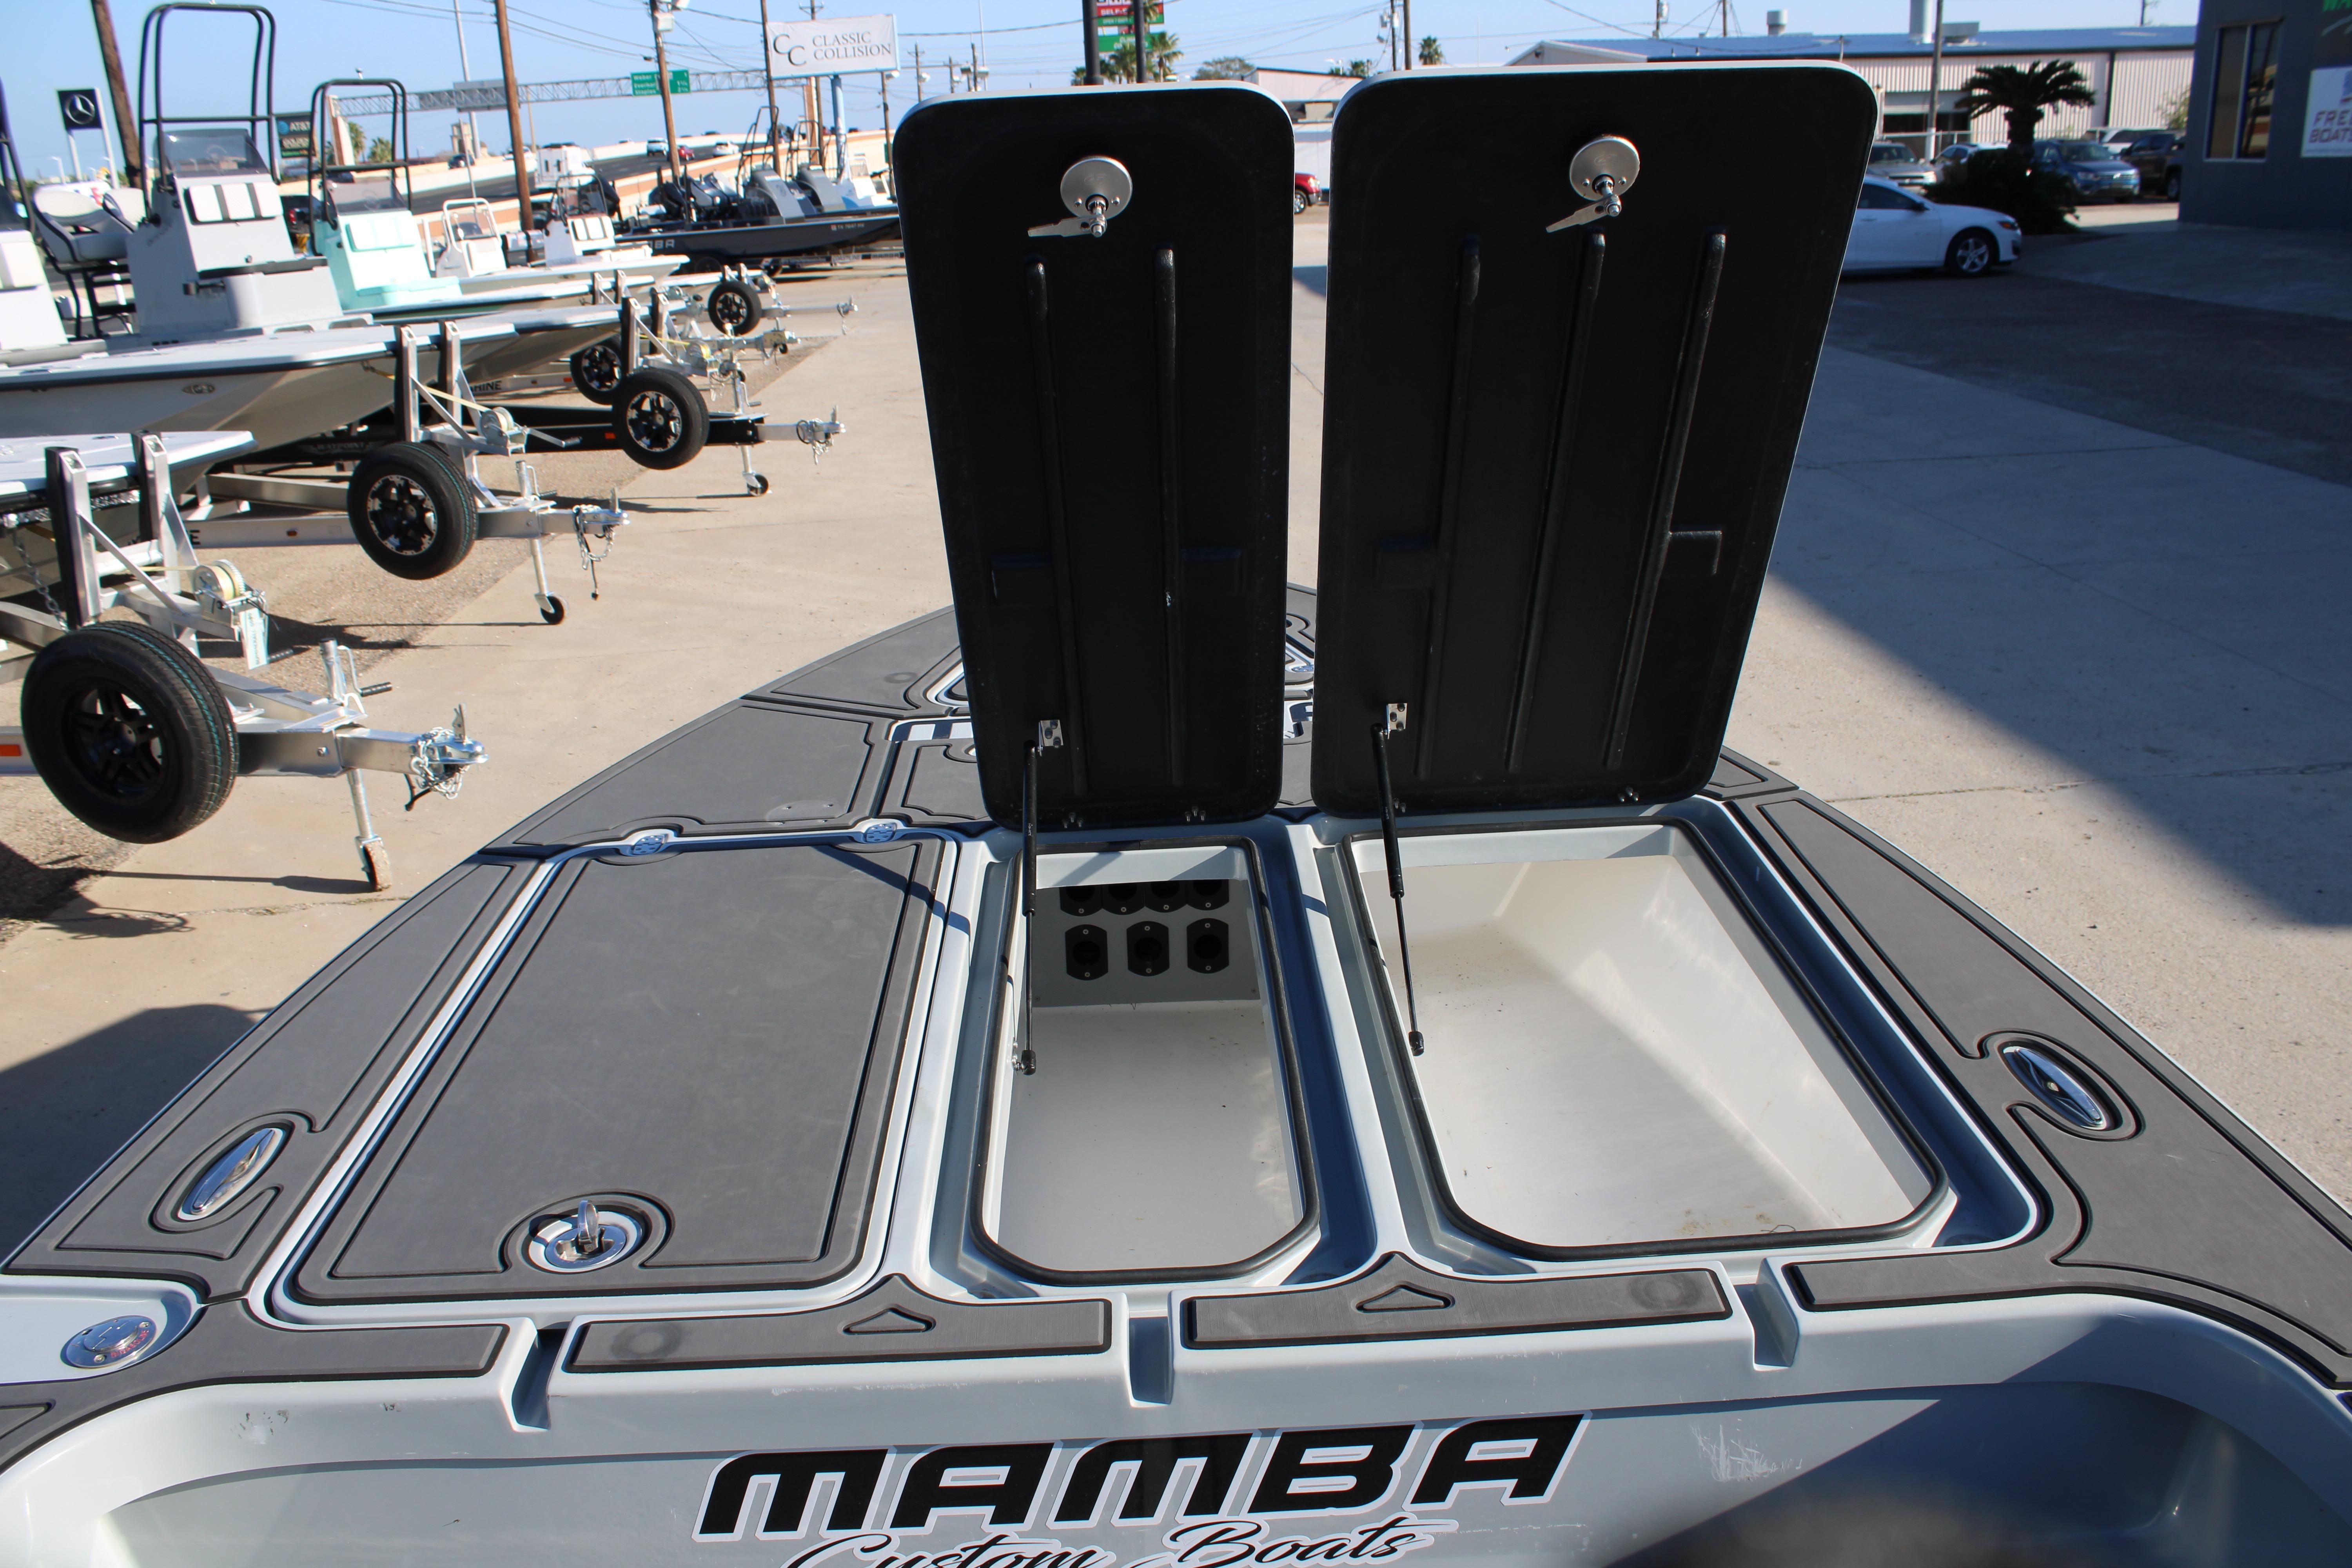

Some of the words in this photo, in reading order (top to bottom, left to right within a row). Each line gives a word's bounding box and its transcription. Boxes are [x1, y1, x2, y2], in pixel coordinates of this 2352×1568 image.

[812, 31, 871, 47] CLASSIC
[813, 43, 891, 60] COLLISION
[290, 121, 311, 131] AT&T
[696, 1412, 1587, 1537] MAMBA
[1169, 1516, 1447, 1568] Boats
